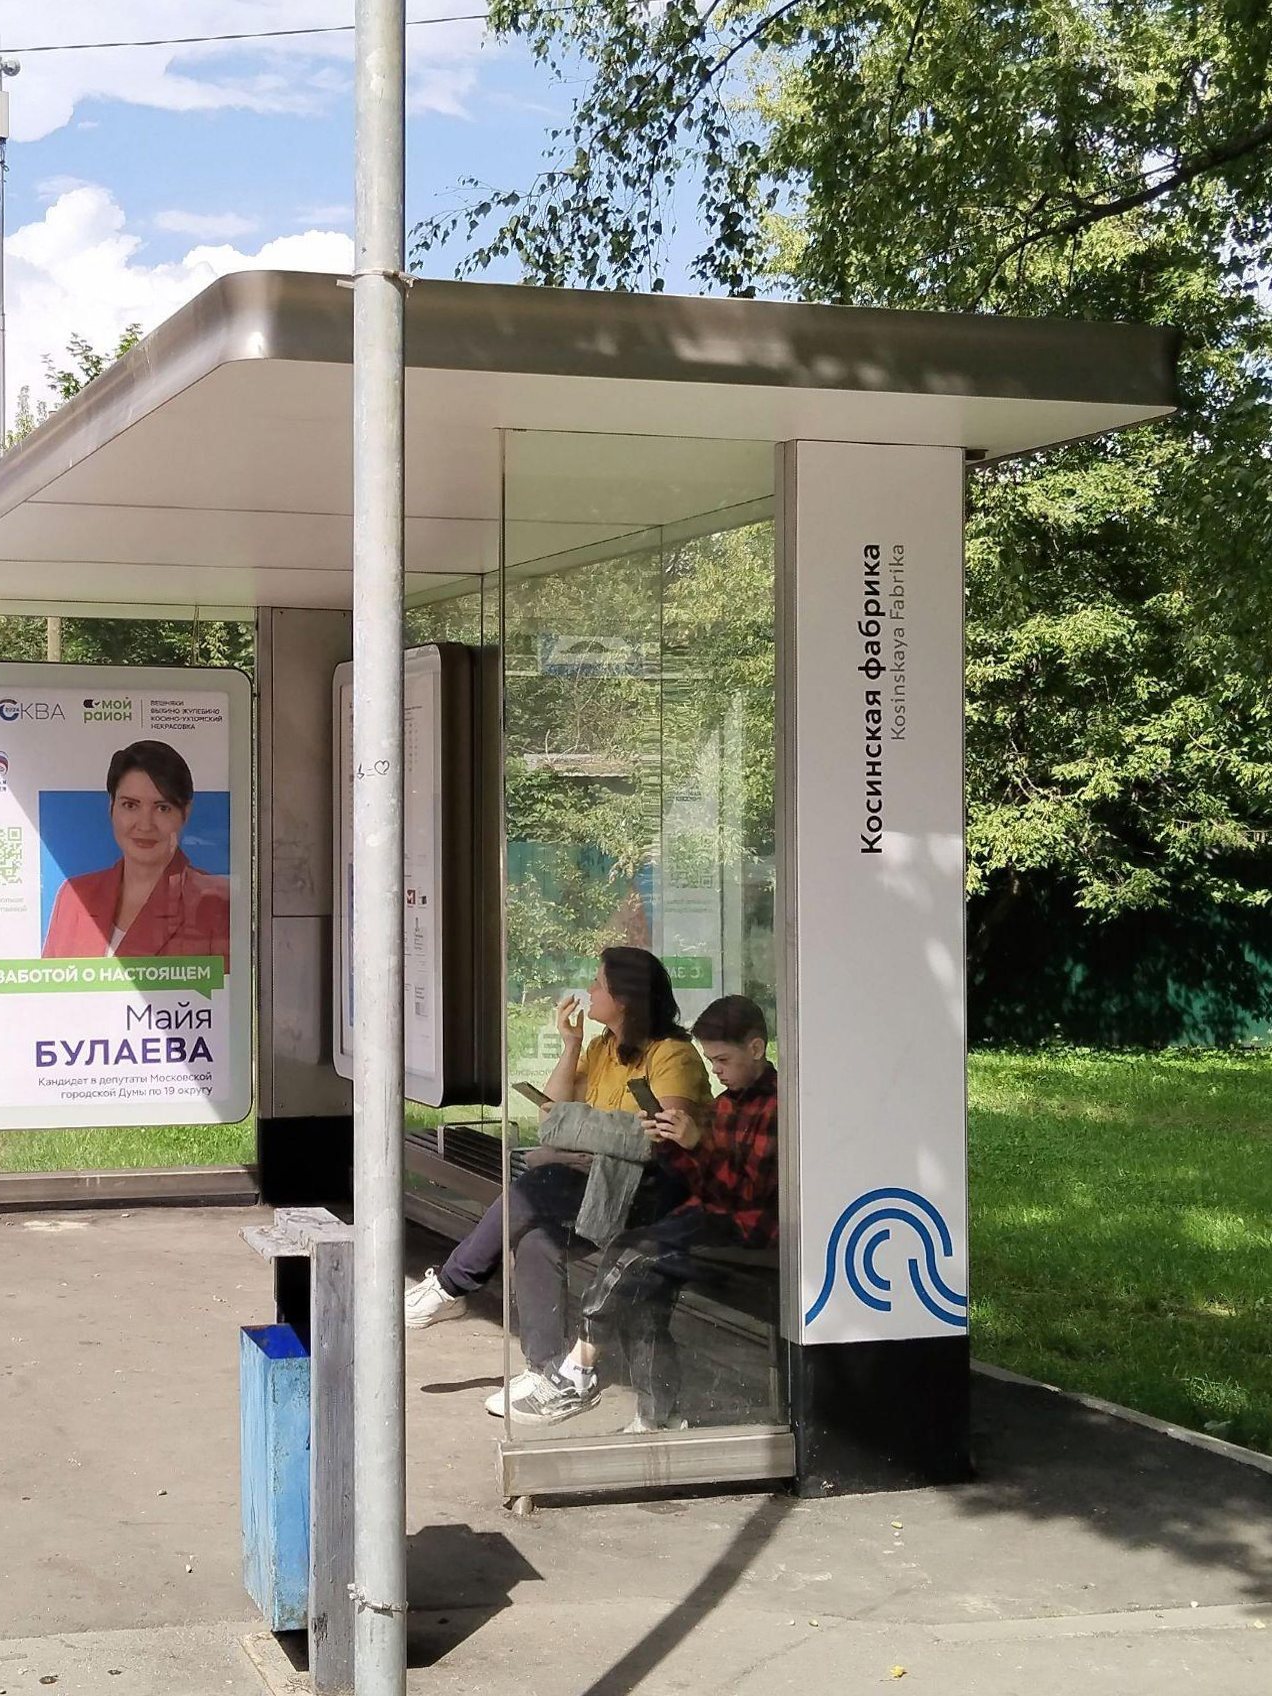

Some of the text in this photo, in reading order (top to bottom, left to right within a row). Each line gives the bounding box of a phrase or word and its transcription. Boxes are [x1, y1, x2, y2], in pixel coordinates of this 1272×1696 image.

[889, 544, 908, 741] Kosinskaya Fabrika
[101, 696, 132, 709] мой
[858, 543, 887, 854] Косинская фабрика
[82, 967, 96, 982] О
[99, 966, 211, 982] НАСТОЯЩЕМ
[127, 1001, 212, 1031] Майя
[35, 1036, 214, 1068] БУЛАЕВА
[38, 1077, 88, 1087] Кандидат
[98, 1076, 148, 1086] депутаты
[150, 1072, 213, 1083] Московской
[60, 1089, 117, 1100] городской
[118, 1088, 147, 1099] Думы
[164, 1086, 175, 1096] 19
[177, 1086, 213, 1097] округу
